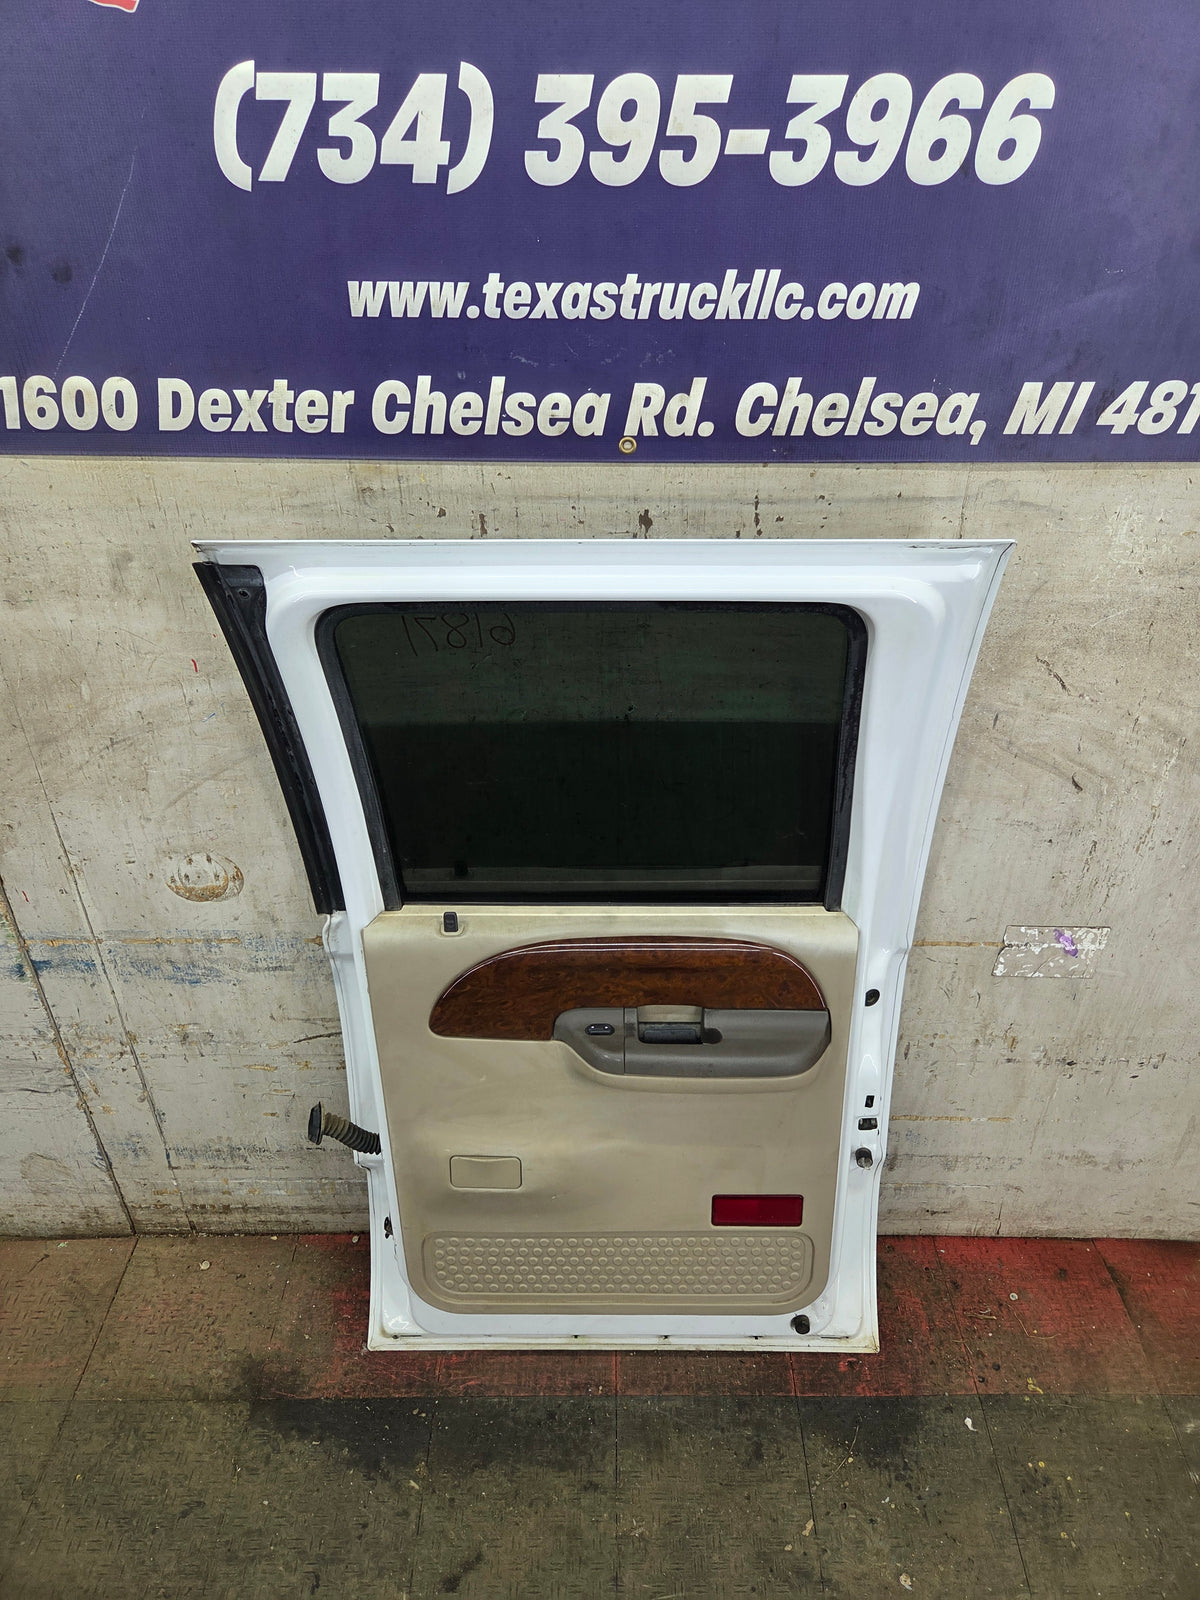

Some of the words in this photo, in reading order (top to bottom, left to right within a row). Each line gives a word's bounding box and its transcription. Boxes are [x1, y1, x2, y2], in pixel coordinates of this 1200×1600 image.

[213, 60, 495, 194] (734)
[525, 73, 1056, 187] 395-3966
[347, 268, 921, 320] www.texastruckllc.com
[0, 375, 139, 431] 1600
[157, 378, 355, 434] Dexter
[372, 375, 612, 437] Chelsea
[623, 376, 715, 438] Rd.
[735, 376, 987, 446] Chelsea,
[1002, 381, 1097, 435] MI
